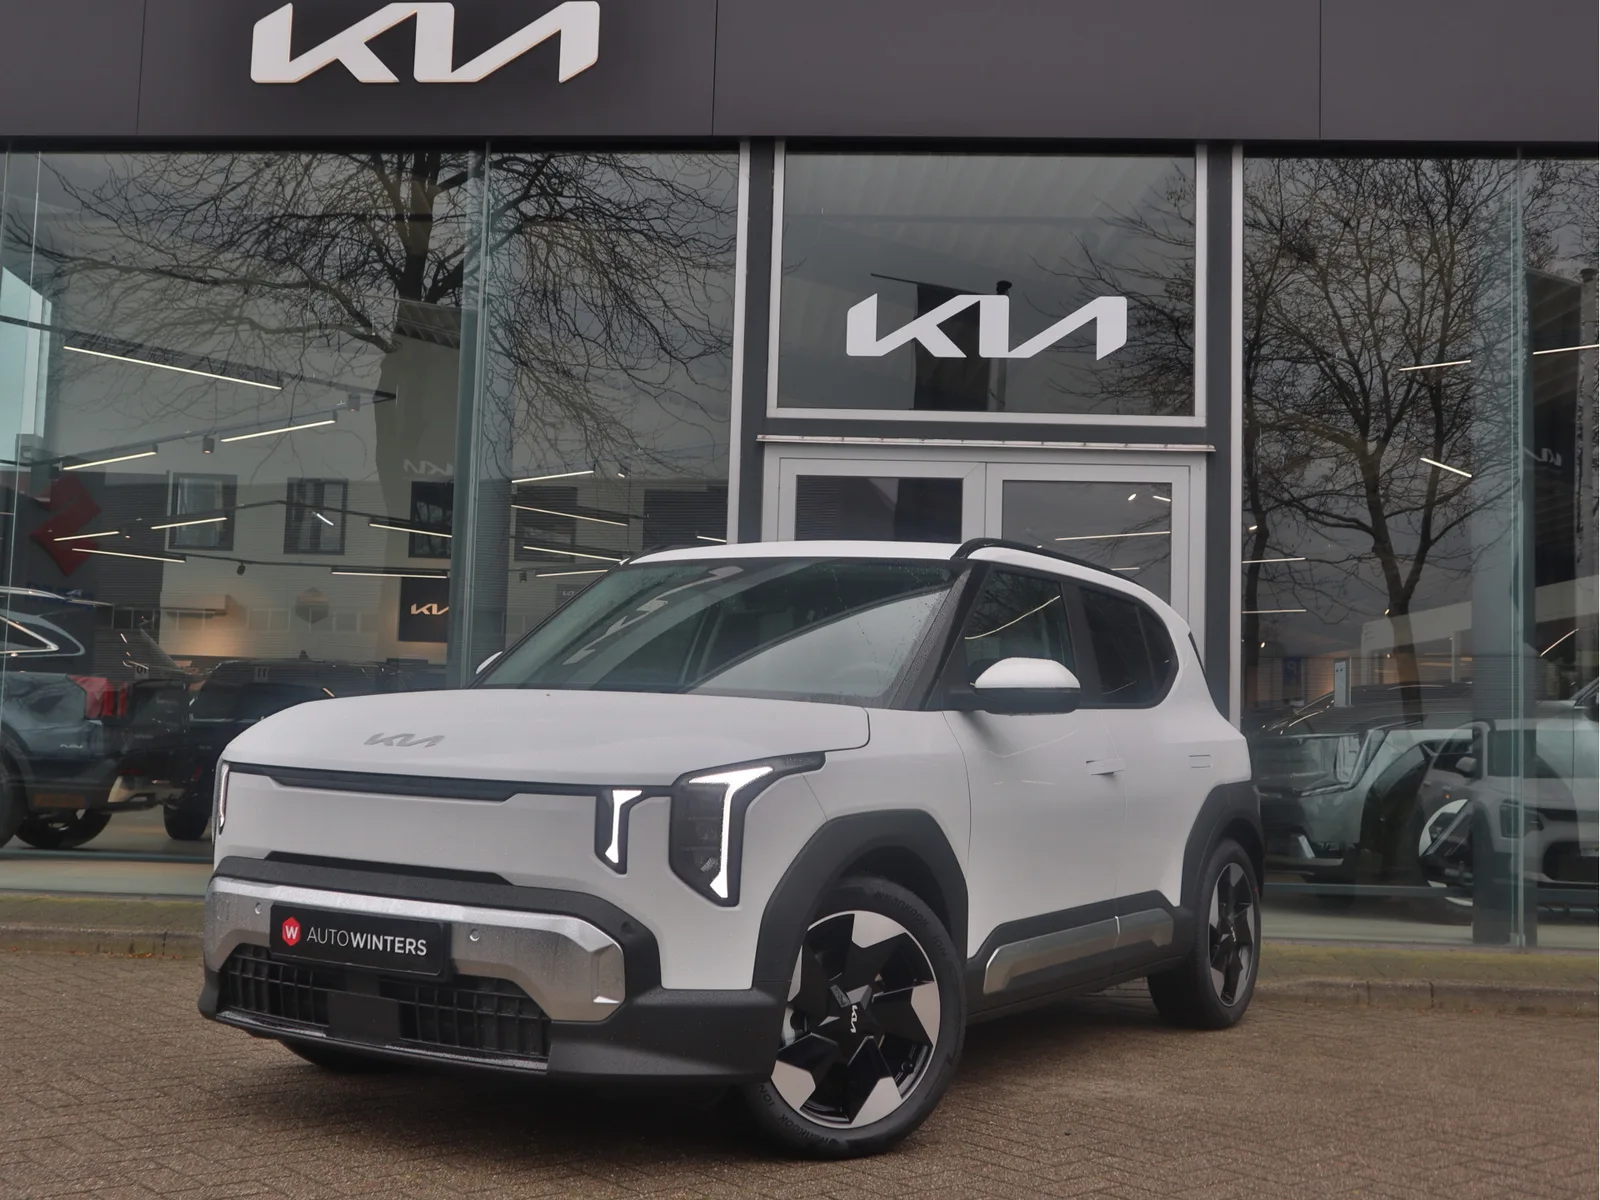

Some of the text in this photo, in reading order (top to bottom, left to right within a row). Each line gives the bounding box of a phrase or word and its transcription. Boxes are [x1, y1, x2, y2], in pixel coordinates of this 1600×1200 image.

[250, 1, 600, 83] KIA
[846, 293, 1127, 360] KIA
[364, 732, 446, 748] KIA
[285, 925, 299, 940] W
